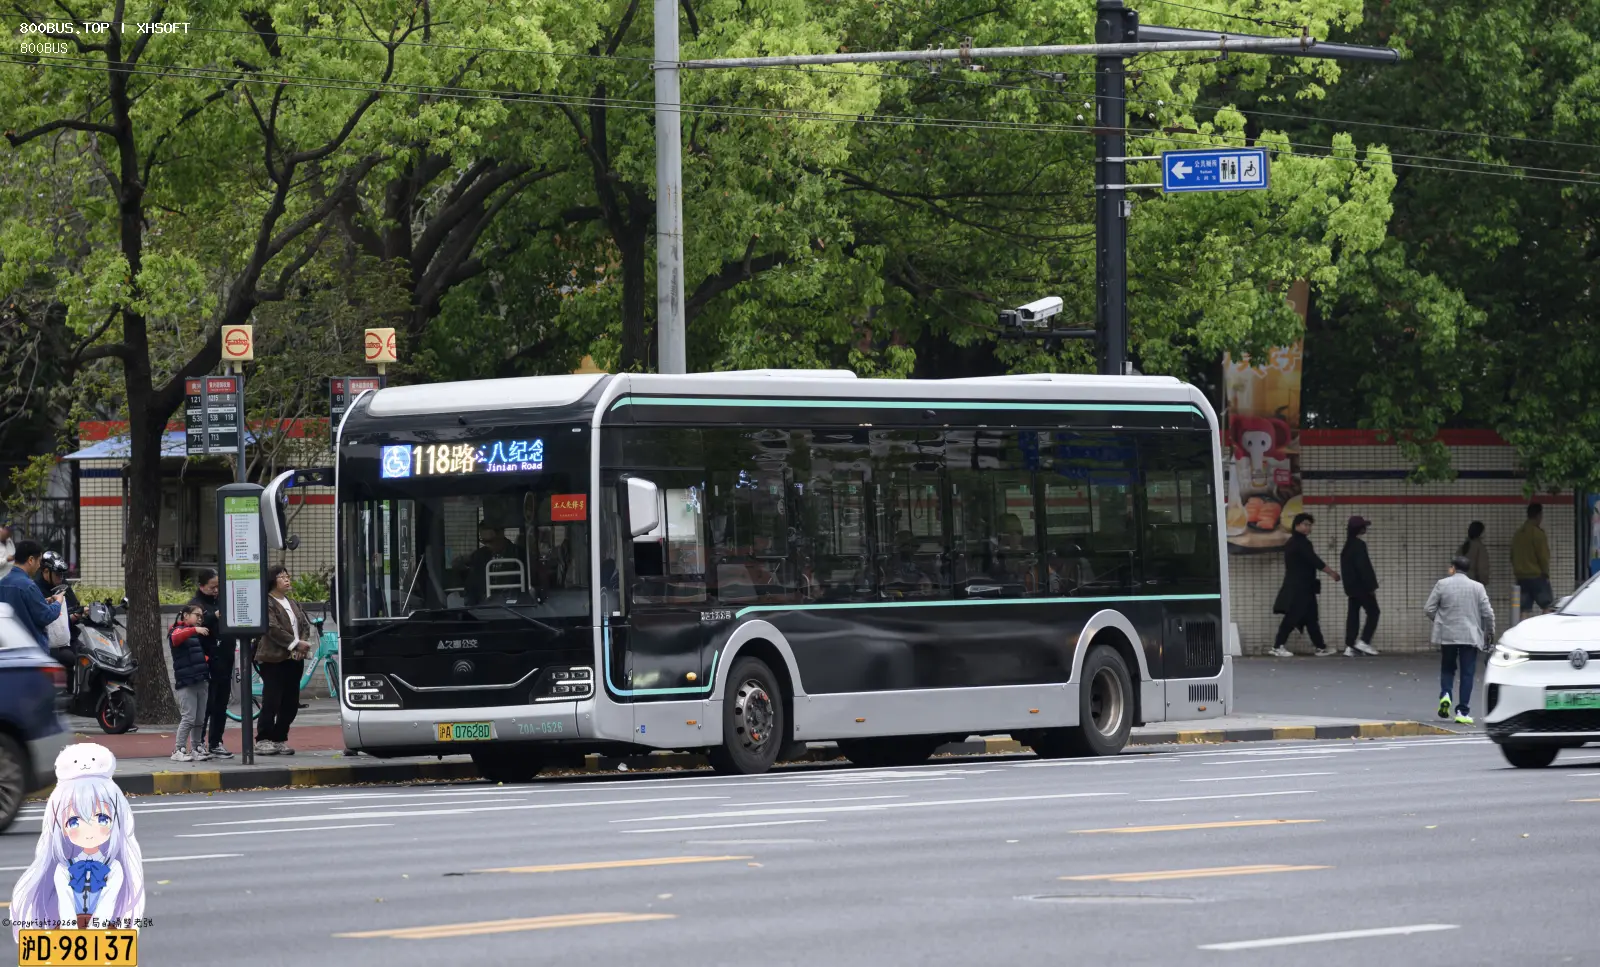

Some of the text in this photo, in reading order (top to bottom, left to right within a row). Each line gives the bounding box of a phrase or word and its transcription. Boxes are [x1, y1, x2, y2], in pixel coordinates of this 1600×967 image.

[209, 413, 234, 422] 538 118
[210, 433, 220, 441] 713
[412, 443, 477, 475] 118路
[486, 461, 543, 473] Jinian Road
